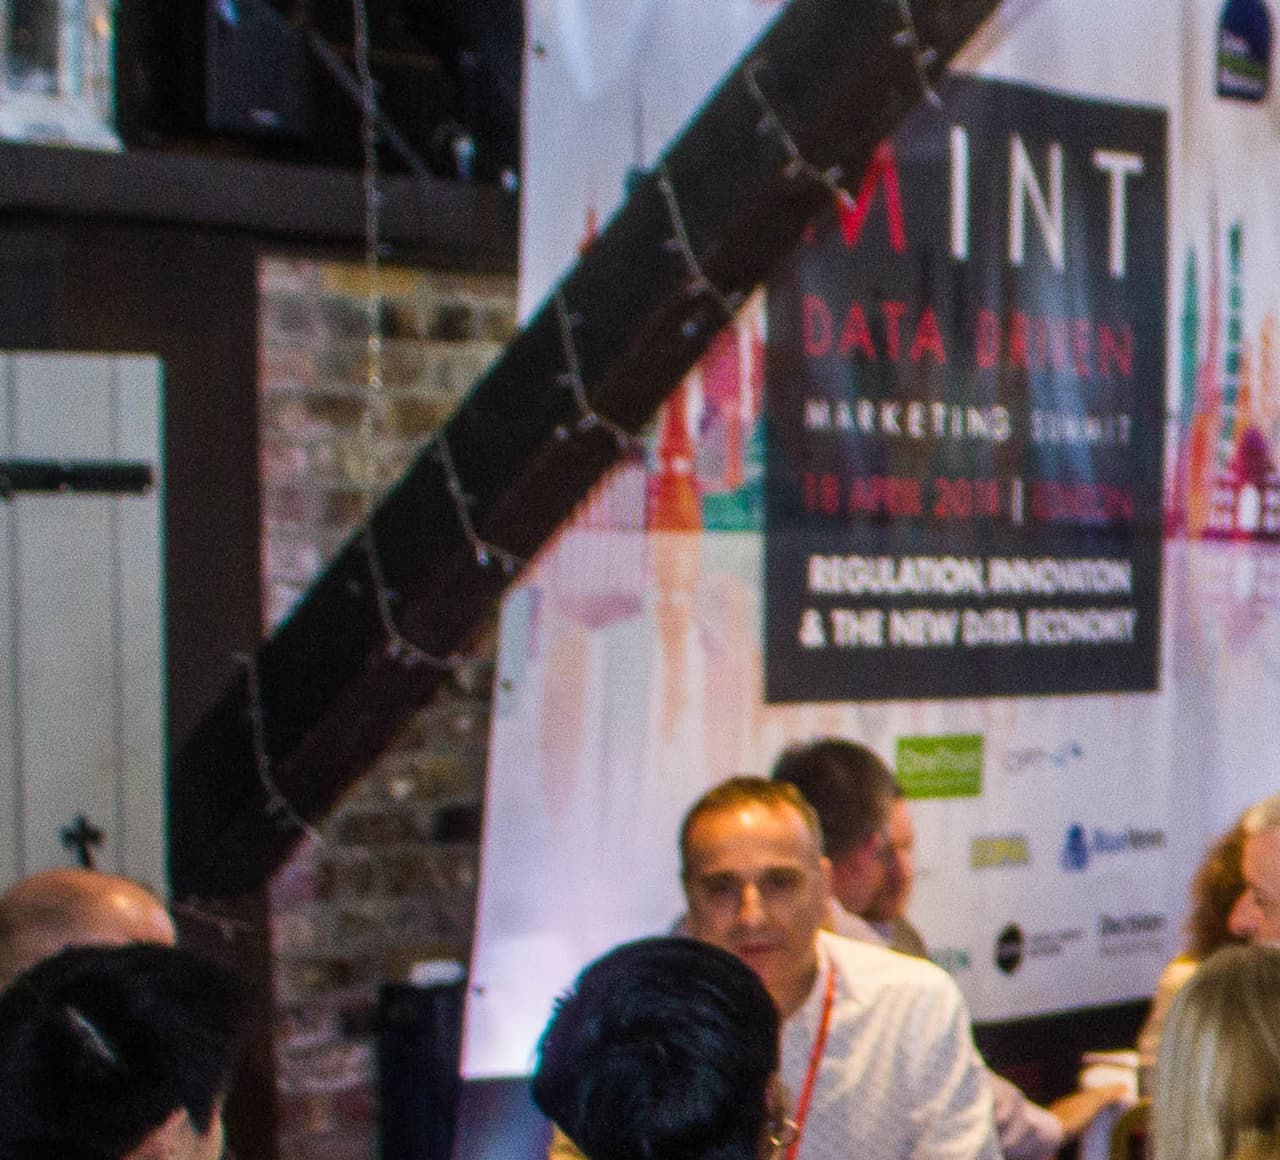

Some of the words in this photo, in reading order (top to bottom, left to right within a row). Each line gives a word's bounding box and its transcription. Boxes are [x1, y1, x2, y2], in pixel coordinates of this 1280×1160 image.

[803, 125, 1145, 279] MINT
[803, 295, 946, 364] DATA
[805, 401, 1011, 443] MARKETING
[988, 557, 1131, 596] INNOVATION
[799, 609, 828, 648] &
[833, 609, 886, 647] THE
[892, 609, 959, 647] NEW
[1027, 608, 1136, 645] ECONOMY
